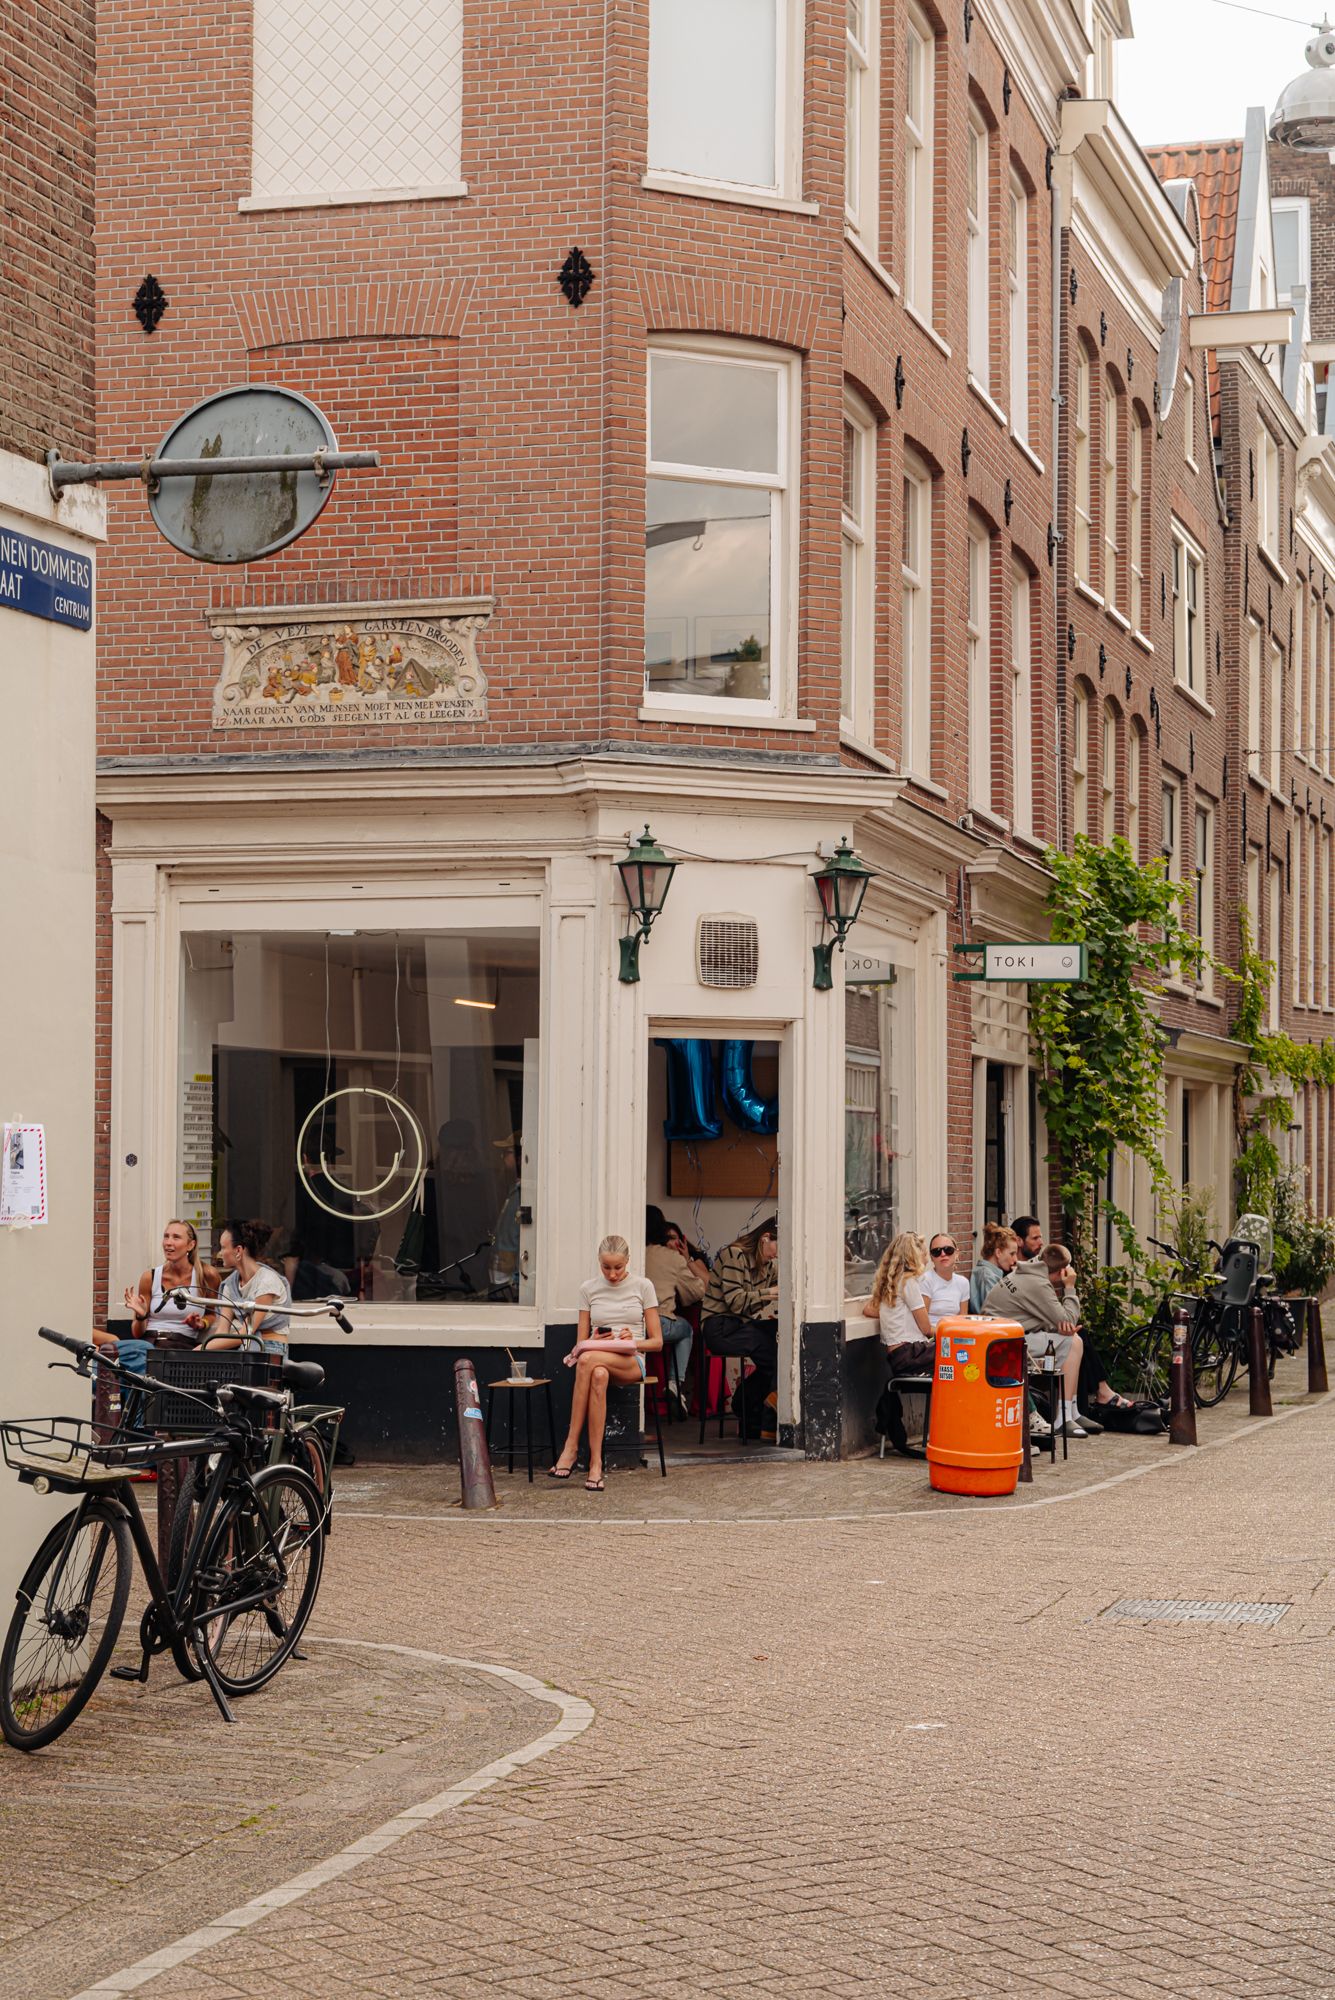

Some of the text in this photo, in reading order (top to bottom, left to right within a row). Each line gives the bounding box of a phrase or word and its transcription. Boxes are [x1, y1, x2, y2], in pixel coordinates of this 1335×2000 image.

[1, 535, 89, 589] NEN DOMMERS
[0, 569, 23, 600] AAT
[54, 596, 89, 621] CENTRUM
[246, 624, 311, 655] DE VEYF
[425, 626, 467, 667] BROODEN
[223, 699, 474, 716] NAAR GUNST VAN MENSEN MOET MEN MEE WENSEN
[233, 716, 265, 725] MAAR
[269, 715, 293, 724] AAN
[299, 714, 326, 723] GODS
[332, 712, 370, 722] SEEGEN
[395, 711, 410, 720] AL
[429, 709, 465, 719] LEEGEN
[994, 956, 1034, 967] TOKI
